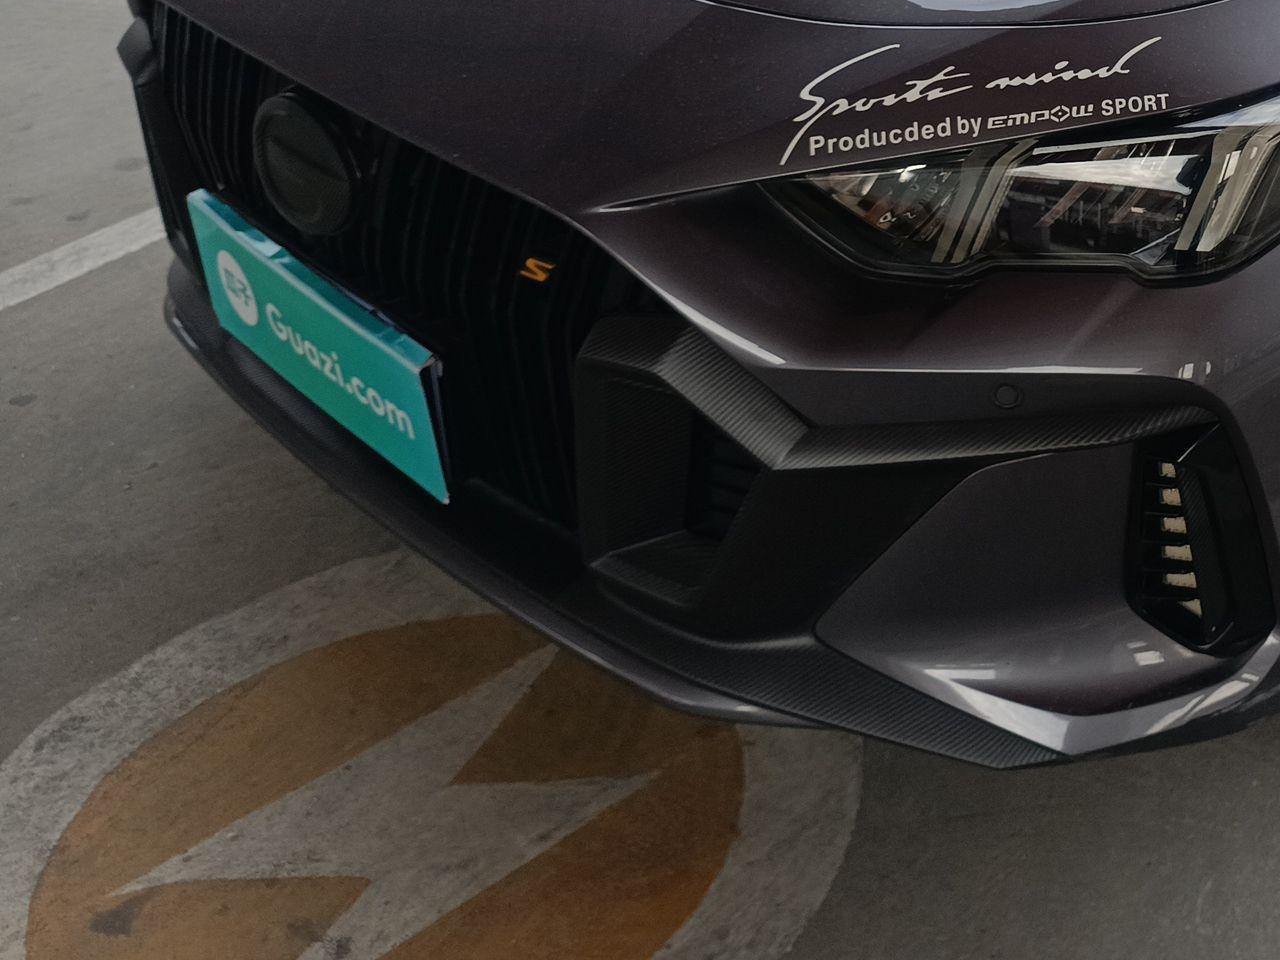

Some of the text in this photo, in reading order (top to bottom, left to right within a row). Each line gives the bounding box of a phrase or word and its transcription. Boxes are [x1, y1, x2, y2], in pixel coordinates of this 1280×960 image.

[985, 37, 1162, 90] mind
[809, 117, 952, 156] Producded
[957, 115, 982, 137] by
[1101, 93, 1169, 117] SPORT
[266, 303, 415, 439] Guazi.com
